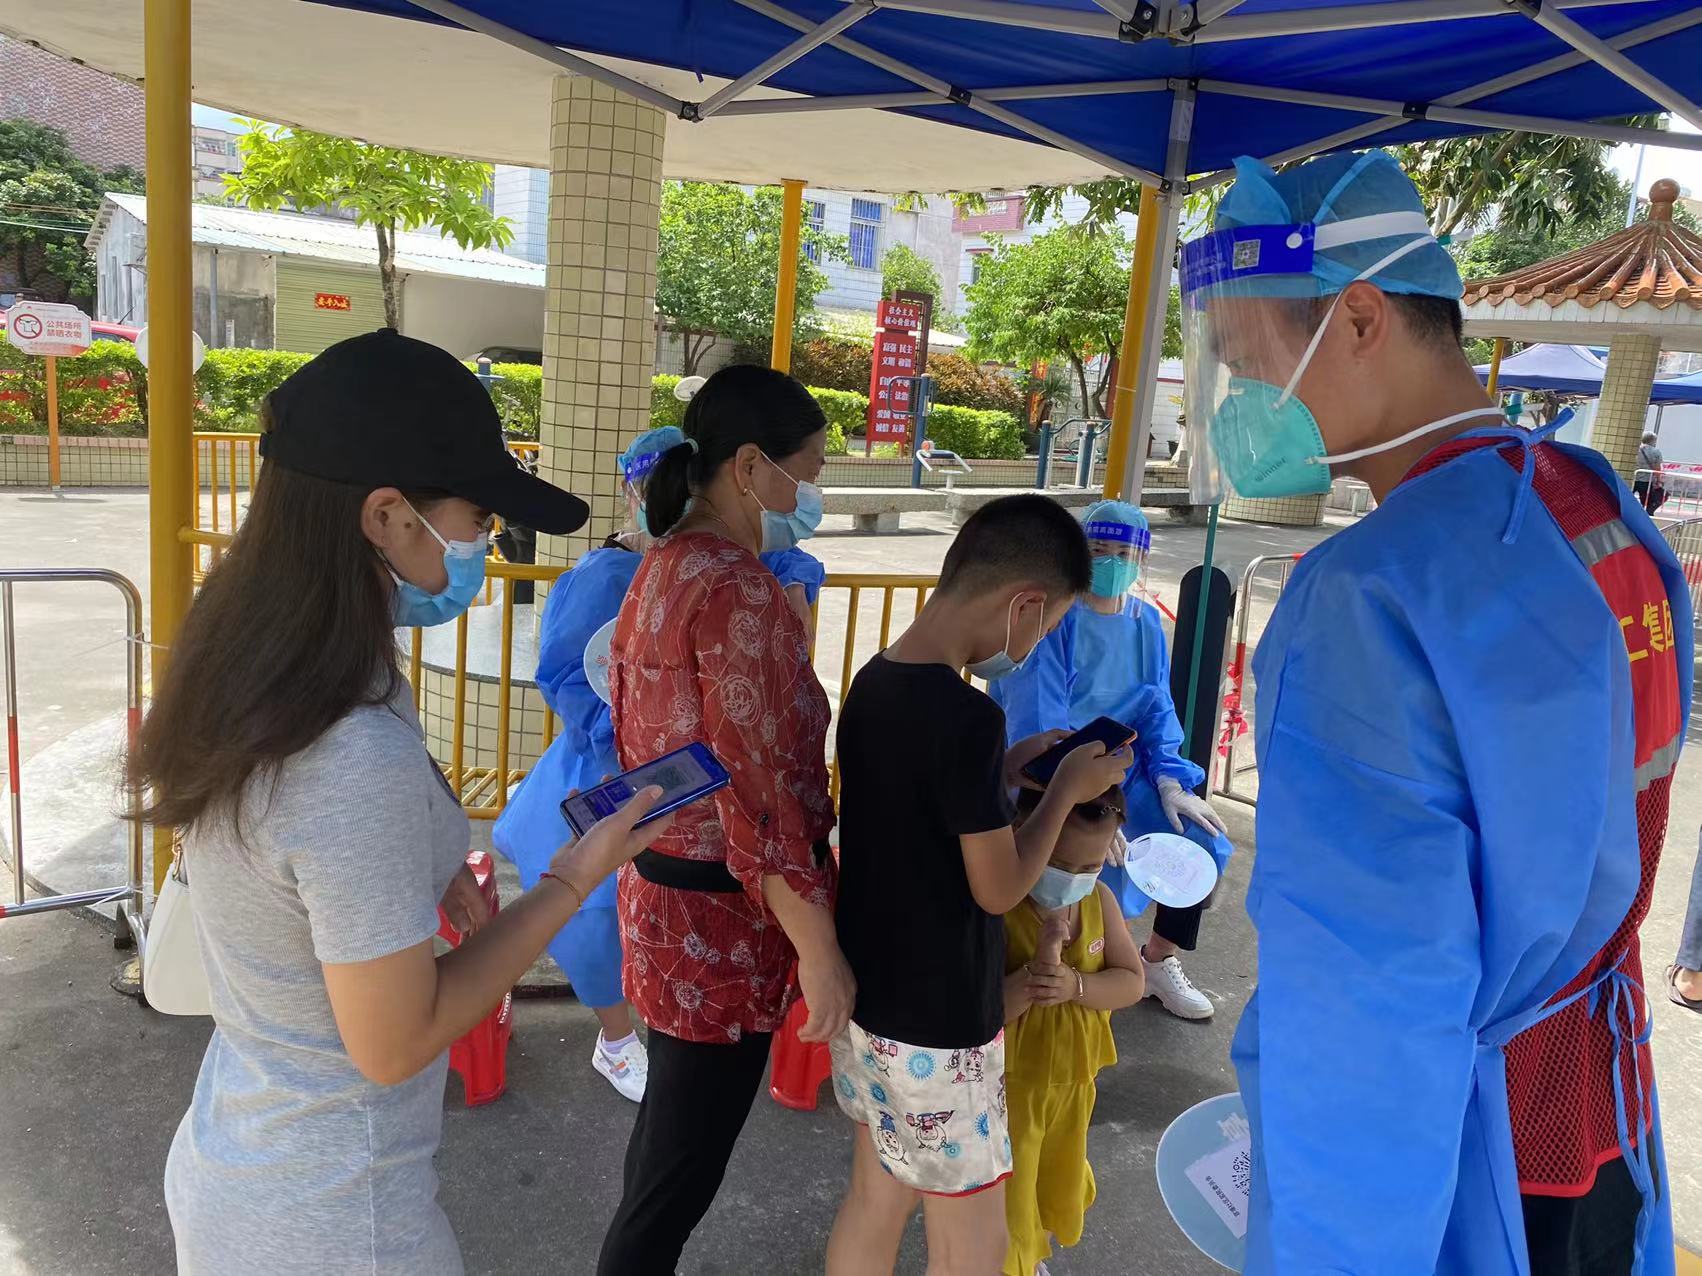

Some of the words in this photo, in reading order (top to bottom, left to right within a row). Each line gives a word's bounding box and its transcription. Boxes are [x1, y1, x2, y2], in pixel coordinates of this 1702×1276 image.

[888, 305, 914, 317] 社会主义
[46, 320, 81, 330] 公共场所
[899, 343, 913, 354] 民主
[881, 356, 896, 367] 文明
